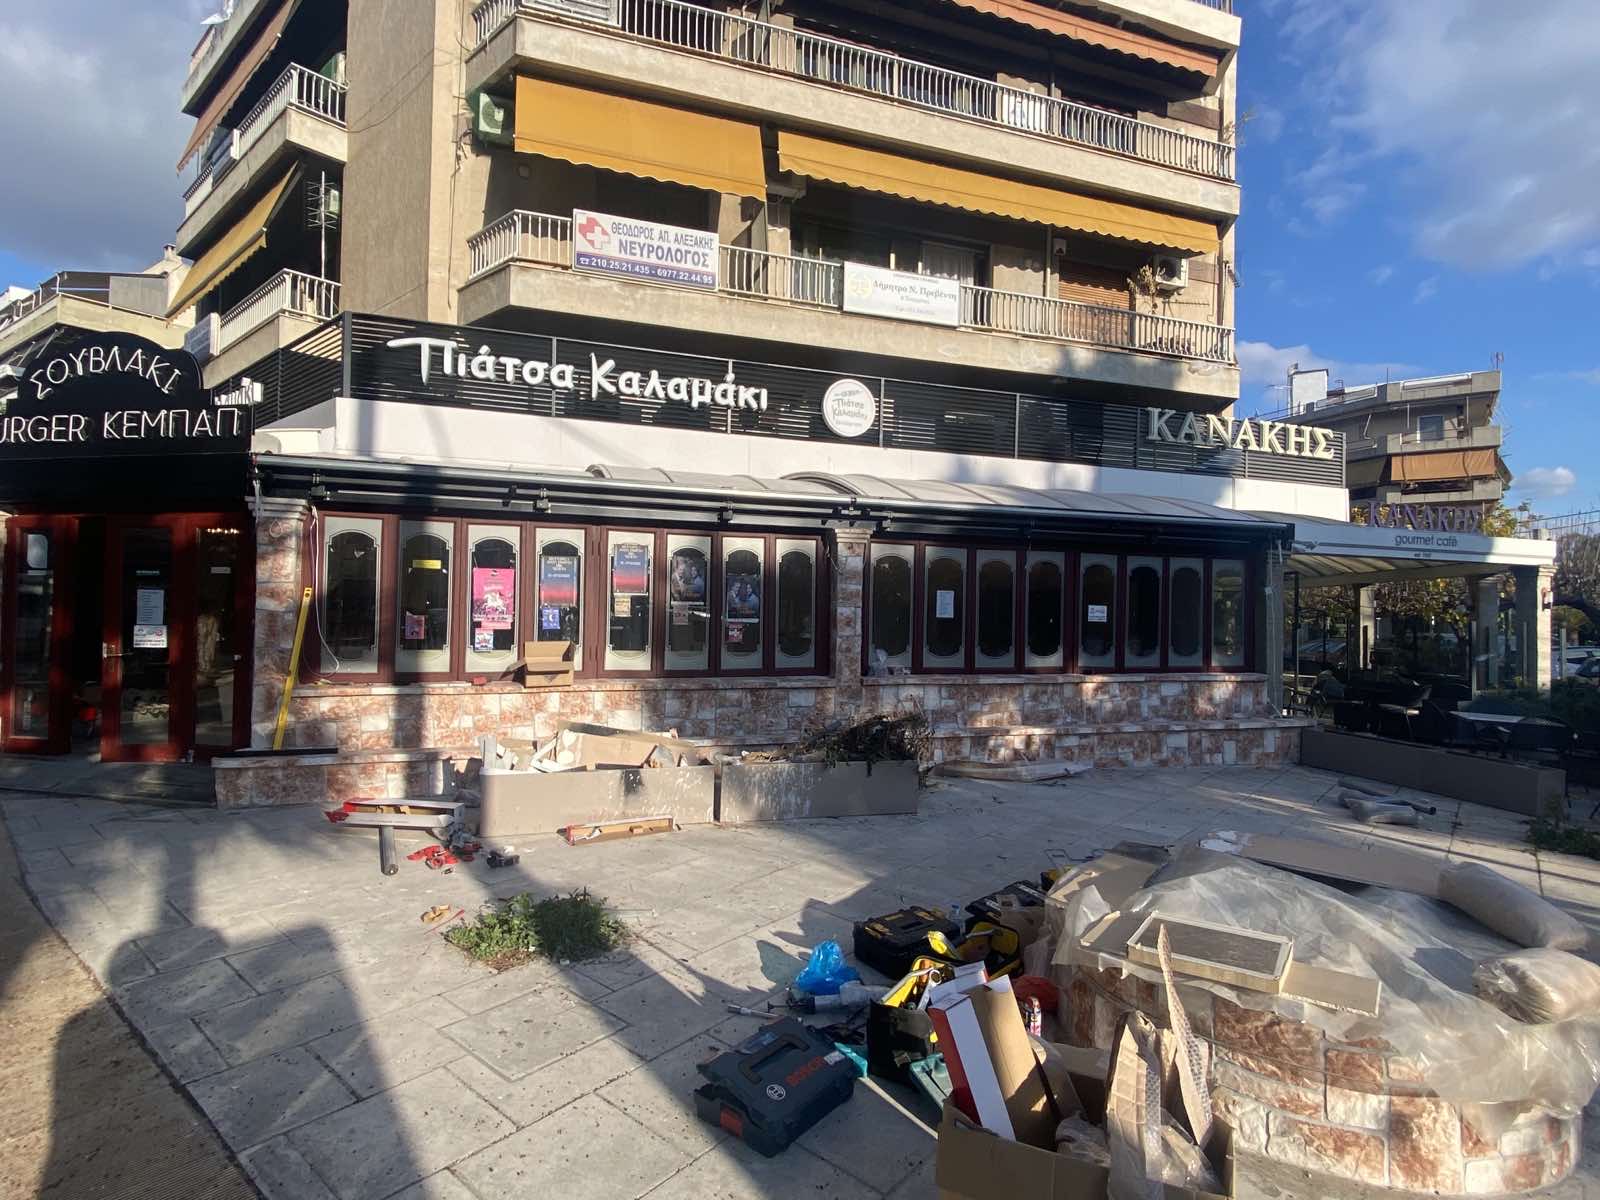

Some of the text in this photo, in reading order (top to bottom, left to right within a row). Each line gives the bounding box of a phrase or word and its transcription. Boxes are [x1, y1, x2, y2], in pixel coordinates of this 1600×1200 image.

[611, 221, 715, 251] ΘΕΟΔΩΡΟΣ ΑΠ. ΑΛΕΞΑΚΗΣ
[618, 239, 710, 268] ΝΕΥΡΟΛΟΓΟΣ
[591, 257, 650, 275] 210.25.21.435
[656, 267, 713, 285] 6977.22.44.95
[29, 345, 182, 400] ΣΟΥΒΛΑΚΙ
[386, 337, 768, 412] Πιάτσα Καλαμάκι
[103, 407, 241, 440] ΚΕΜΠΑΠ
[1146, 406, 1335, 460] ΚΑΝΑΚΗΣ
[1368, 500, 1482, 534] ΚΑΝΑΚΗΣ
[1394, 534, 1435, 547] gourmet
